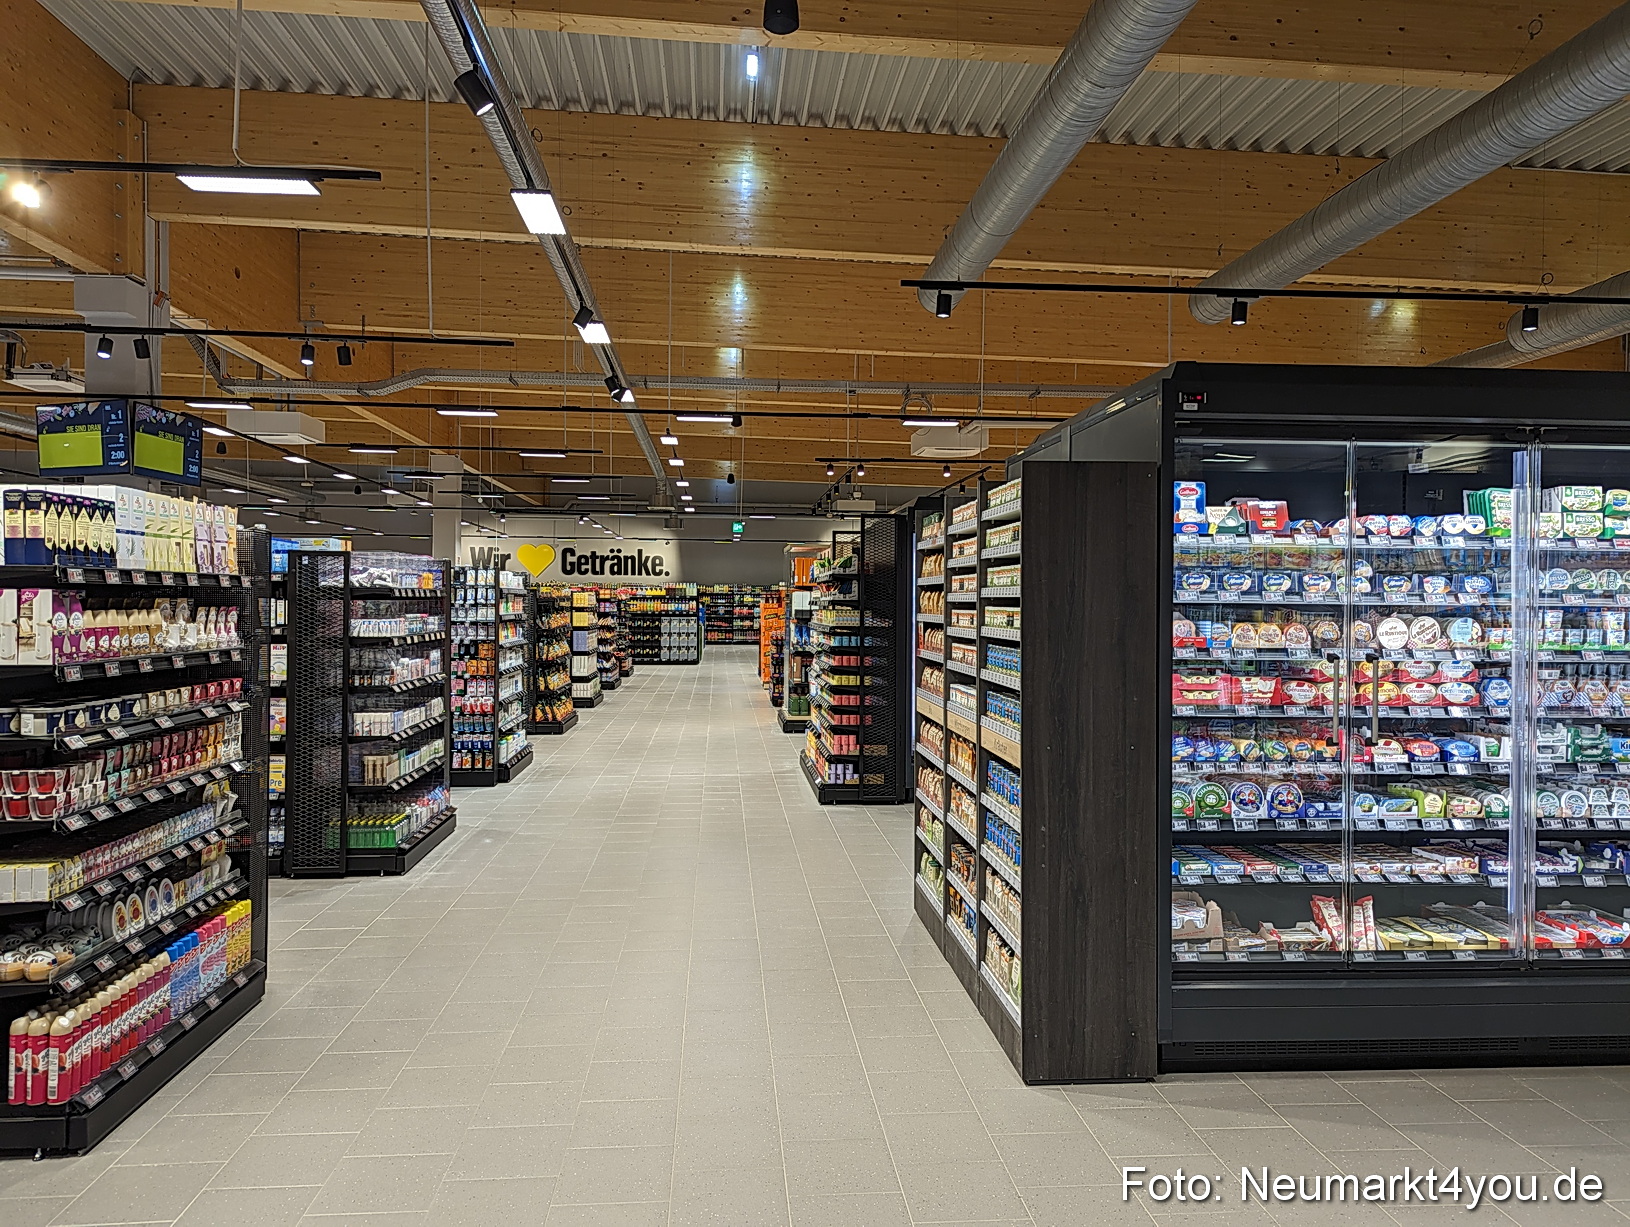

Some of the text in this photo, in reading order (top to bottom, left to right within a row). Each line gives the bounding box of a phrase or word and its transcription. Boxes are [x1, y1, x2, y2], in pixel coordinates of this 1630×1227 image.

[66, 424, 102, 433] SIE SIND DRAN
[110, 450, 125, 460] 2:00
[470, 546, 671, 577] Wir Getränke.
[1286, 686, 1314, 694] Géramont
[270, 779, 282, 787] Pre
